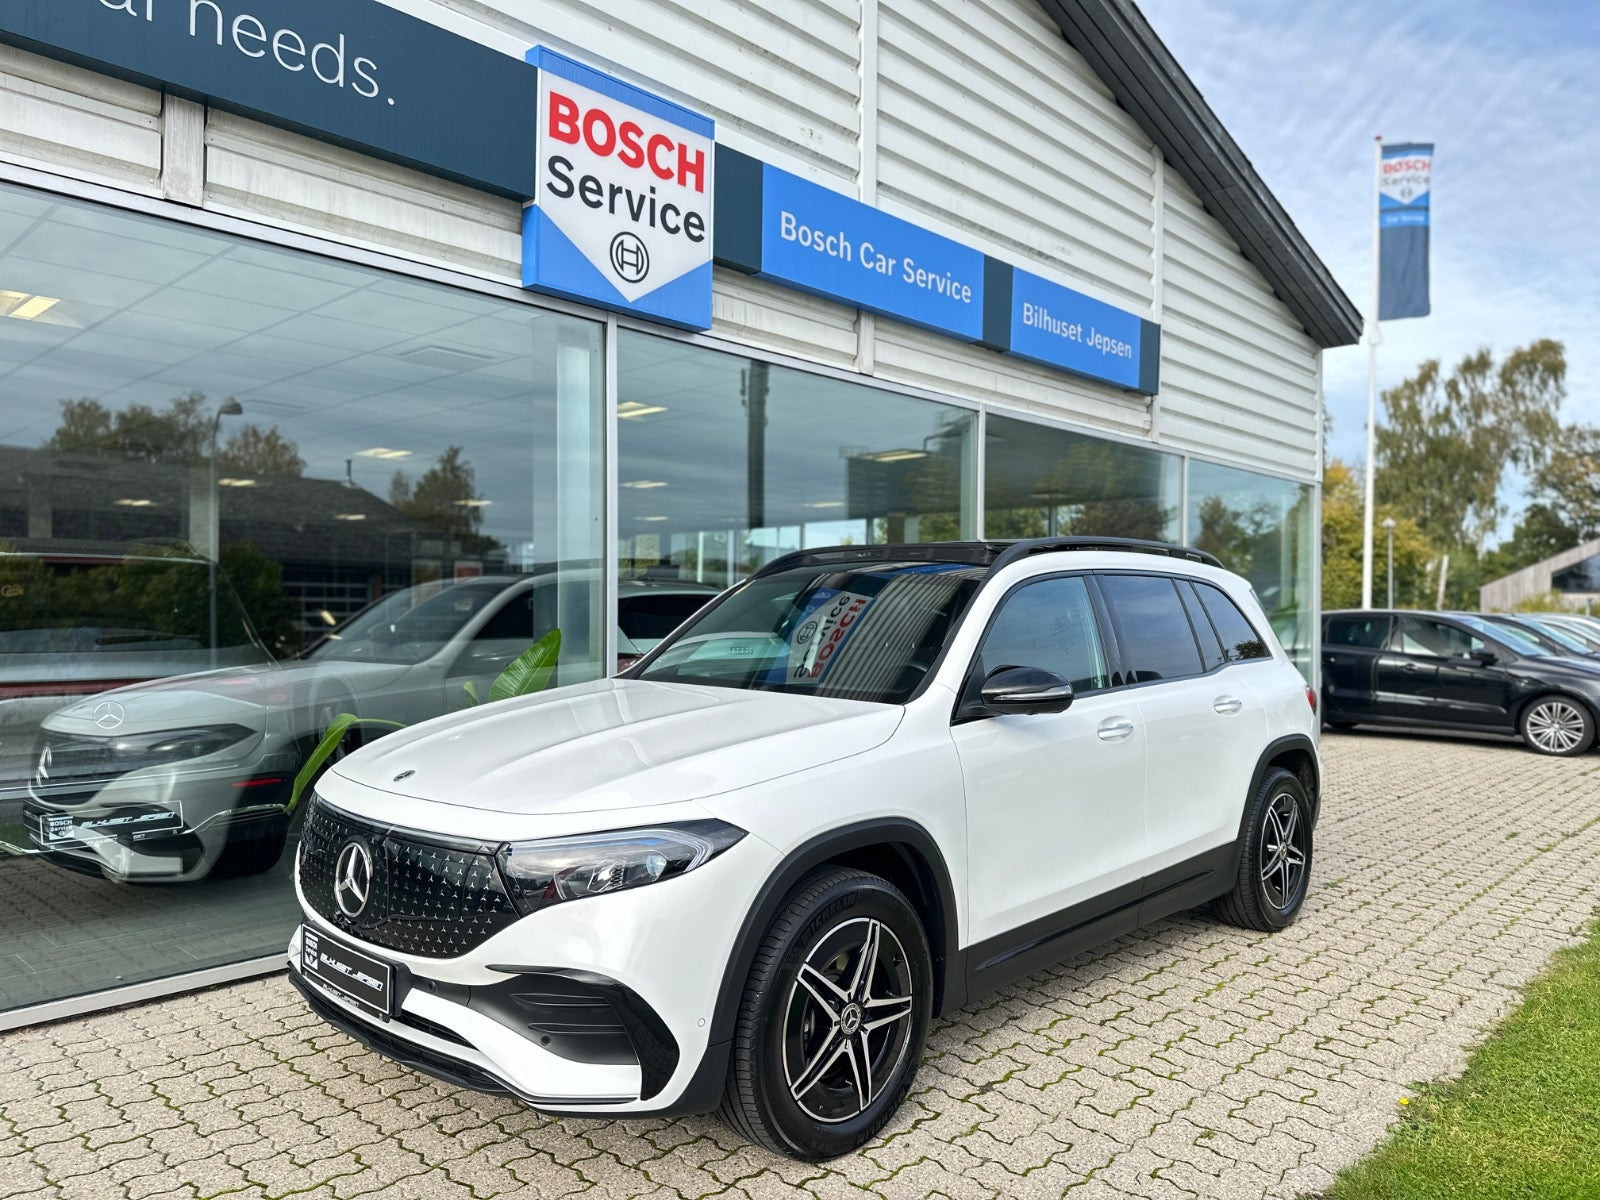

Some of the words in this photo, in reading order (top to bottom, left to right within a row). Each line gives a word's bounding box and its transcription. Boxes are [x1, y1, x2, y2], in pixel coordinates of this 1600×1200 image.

[189, 0, 395, 106] needs.
[549, 91, 704, 193] BOSCH
[1383, 160, 1431, 174] BOSCH
[546, 155, 705, 242] Service
[780, 211, 851, 262] Bosch
[859, 242, 896, 276] Car
[903, 257, 972, 303] Service
[1023, 302, 1082, 342] Bilhuset
[1086, 327, 1132, 359] Jepsen
[50, 819, 73, 827] BOSCH
